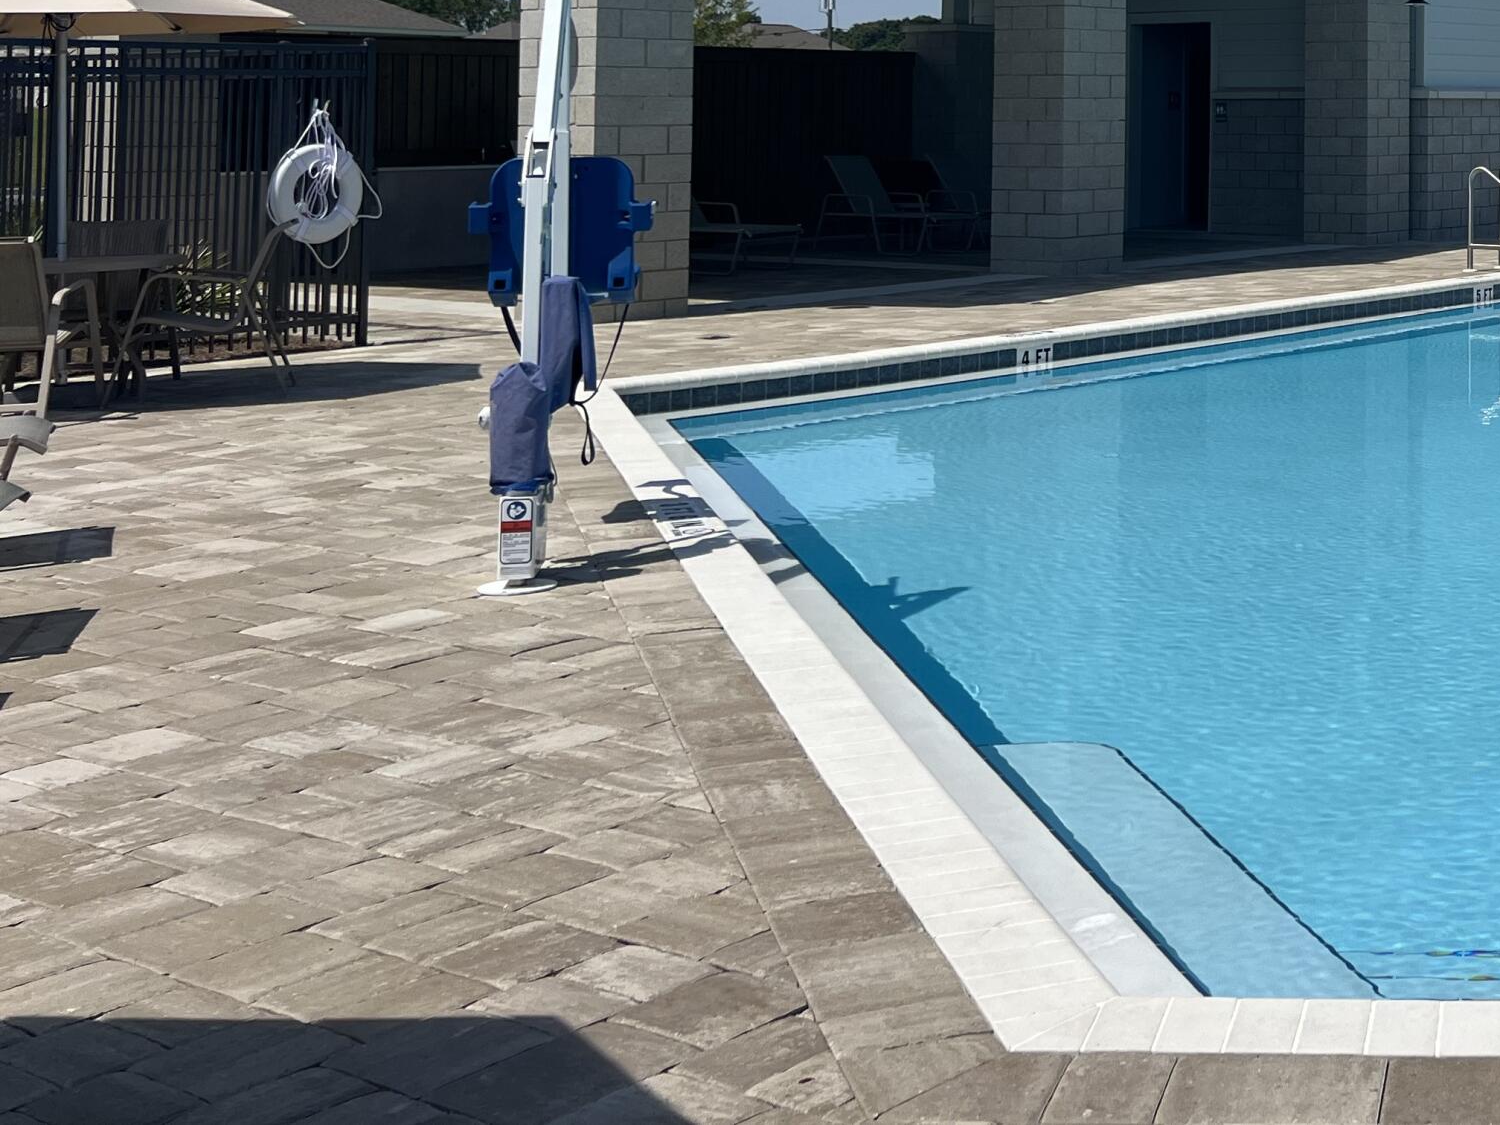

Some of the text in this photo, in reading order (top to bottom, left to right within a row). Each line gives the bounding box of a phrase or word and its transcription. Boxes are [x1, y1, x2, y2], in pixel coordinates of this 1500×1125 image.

[1484, 287, 1492, 301] FT
[1022, 348, 1051, 365] 4 FT
